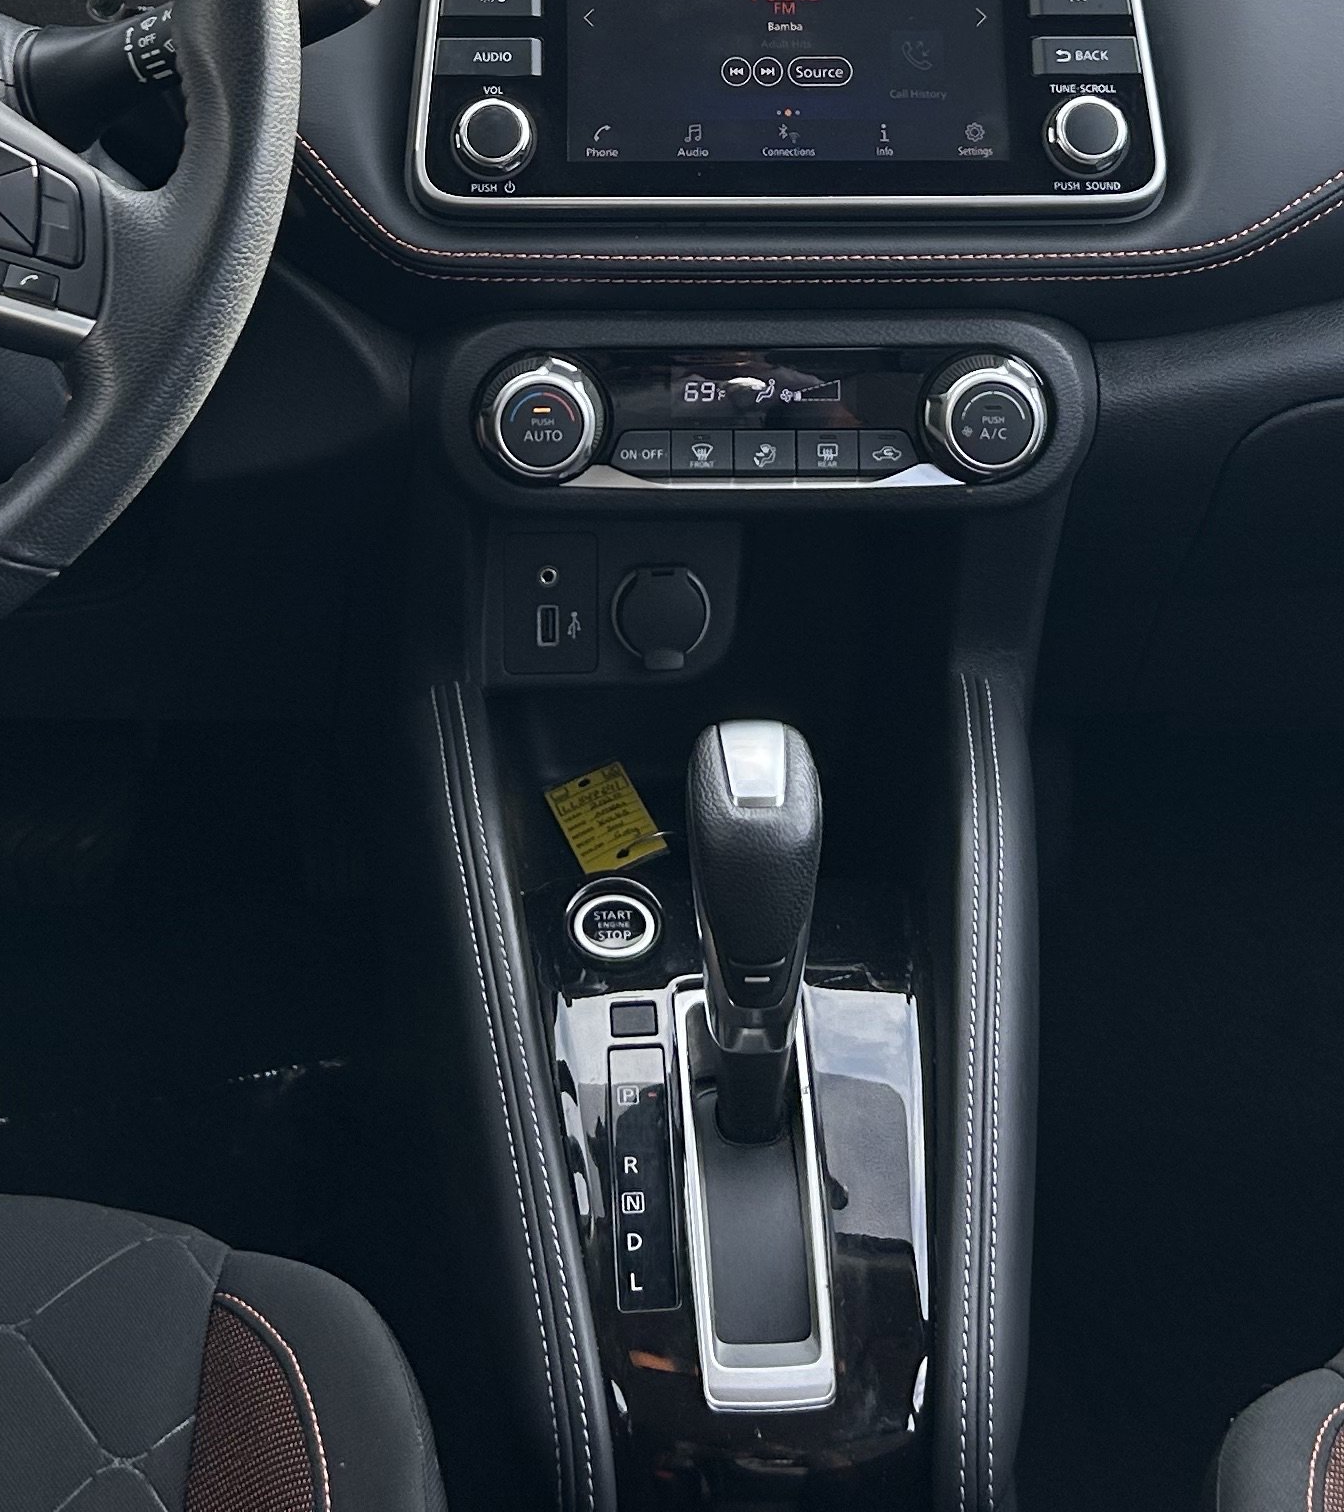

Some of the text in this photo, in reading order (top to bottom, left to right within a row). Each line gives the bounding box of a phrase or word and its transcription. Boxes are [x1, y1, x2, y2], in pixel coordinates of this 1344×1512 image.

[774, 2, 796, 15] FM
[768, 21, 803, 32] Bamba
[138, 33, 157, 48] OFF
[473, 51, 512, 63] AUDIO
[1075, 50, 1109, 61] BACK
[795, 66, 844, 79] Source
[483, 86, 504, 95] VOL
[890, 89, 947, 101] Call History
[586, 147, 619, 158] Phone
[677, 147, 709, 157] Audio
[762, 147, 815, 157] Connections
[876, 147, 894, 157] Info
[958, 147, 994, 158] Settings
[471, 183, 497, 193] PUSH
[1054, 181, 1121, 191] PUSH SOUND
[531, 418, 555, 426] PUSH
[982, 416, 1005, 424] PUSH
[524, 430, 563, 442] AUTO
[979, 427, 1008, 439] A/C
[689, 460, 714, 468] FRONT
[593, 910, 633, 921] START
[597, 921, 630, 929] ENGINE
[598, 930, 632, 941] STOP
[622, 1088, 635, 1102] P
[624, 1156, 639, 1174] R
[626, 1195, 640, 1211] N
[627, 1232, 643, 1251] D
[630, 1272, 643, 1292] L
